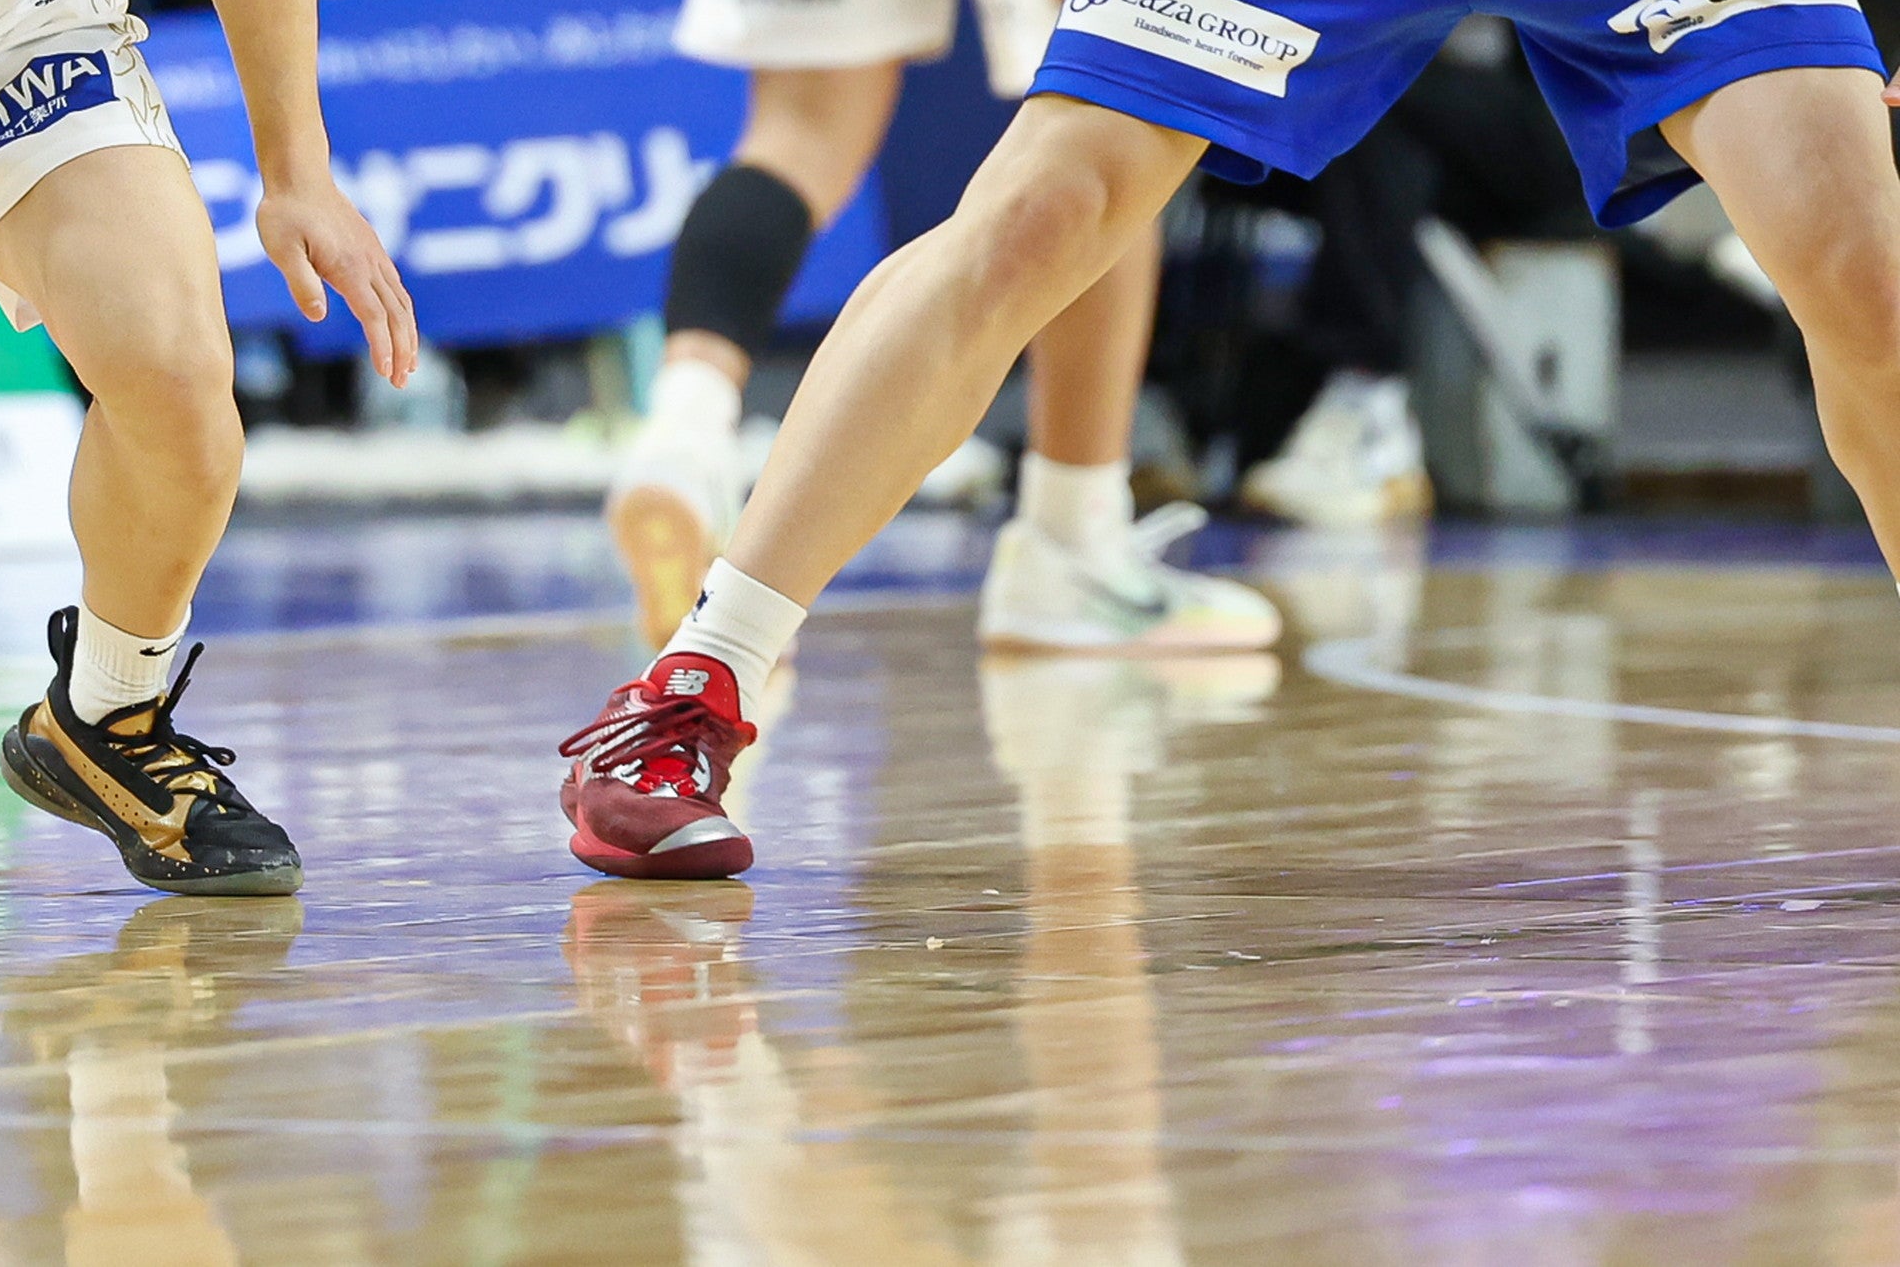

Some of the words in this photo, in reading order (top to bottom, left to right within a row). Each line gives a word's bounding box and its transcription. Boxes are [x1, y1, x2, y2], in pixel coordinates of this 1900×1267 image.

[1133, 17, 1193, 46] Handsome
[1194, 39, 1224, 58] heart
[1196, 12, 1299, 63] GROUP
